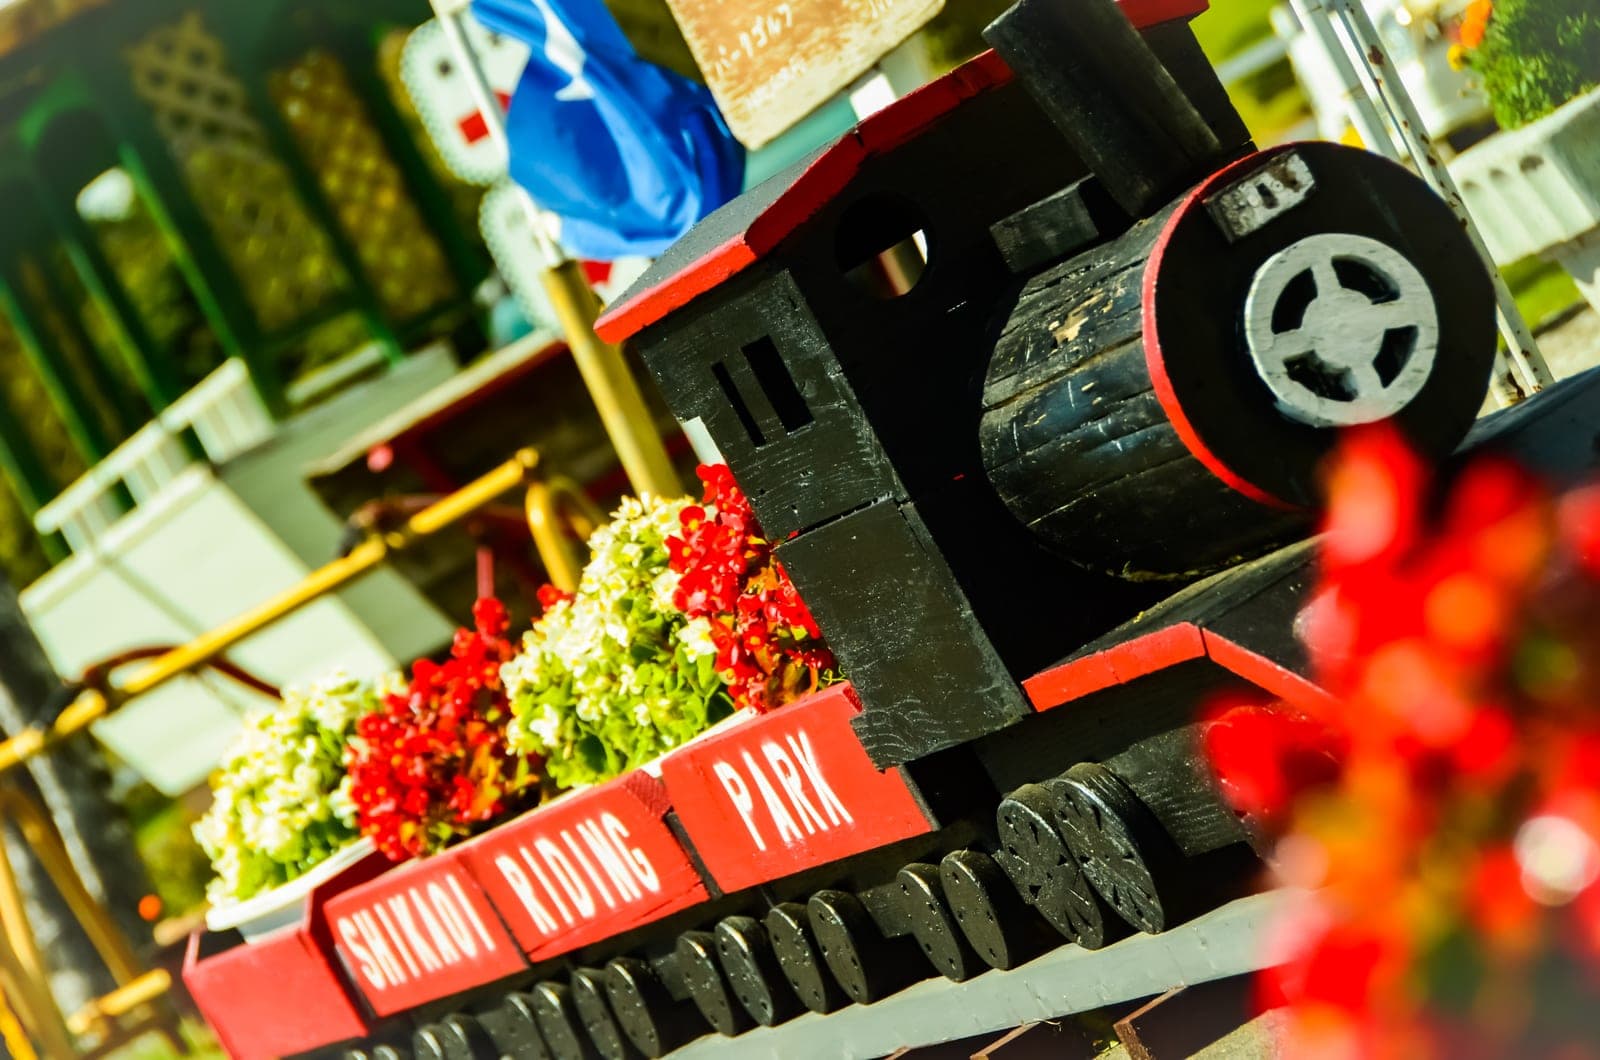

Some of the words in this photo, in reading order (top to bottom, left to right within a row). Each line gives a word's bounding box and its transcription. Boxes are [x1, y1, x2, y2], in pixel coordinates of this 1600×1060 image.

[336, 874, 496, 991] SHIKAOI
[494, 811, 661, 936] RIDING
[713, 730, 855, 852] PARK
